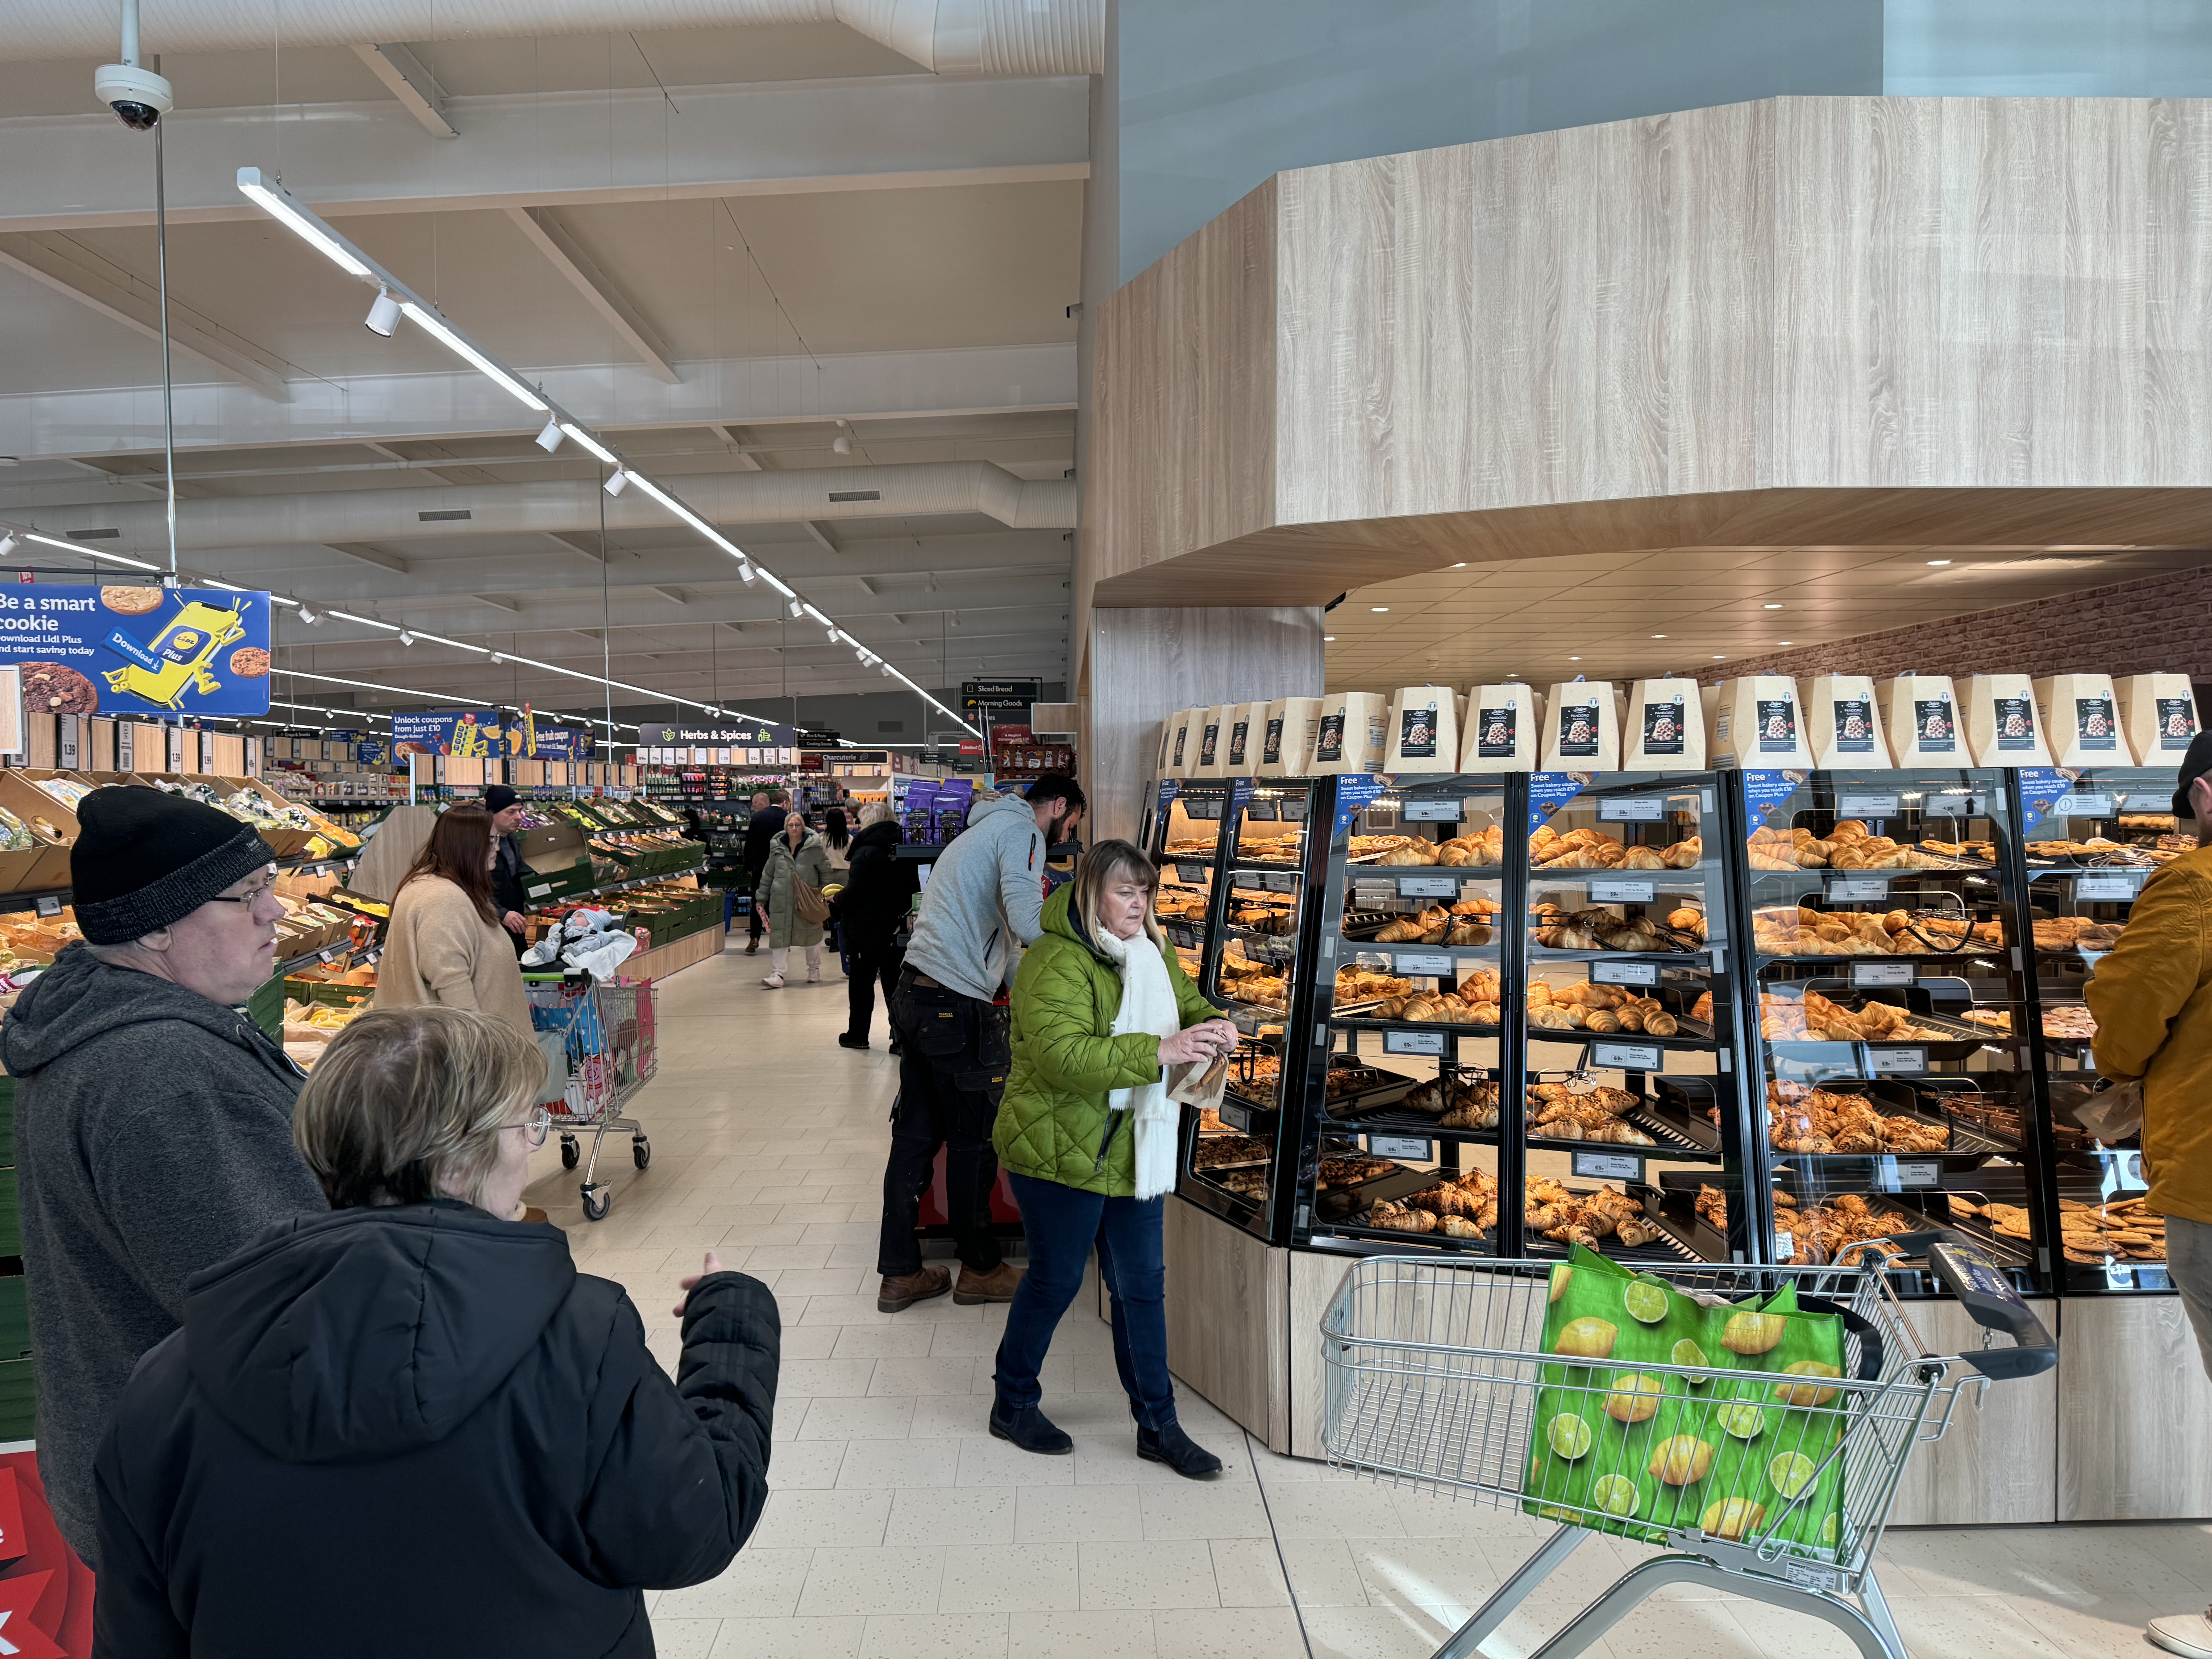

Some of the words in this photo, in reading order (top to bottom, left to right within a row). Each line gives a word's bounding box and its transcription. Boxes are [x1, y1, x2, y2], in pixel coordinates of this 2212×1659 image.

[0, 592, 19, 609] Be
[24, 599, 36, 610] a
[40, 598, 96, 611] smart
[0, 615, 58, 631] cookie
[0, 634, 41, 643] ownload
[43, 635, 60, 643] Lidl
[62, 635, 82, 644] Plus
[0, 645, 11, 653] nd
[36, 646, 67, 656] saving
[69, 647, 94, 656] today
[112, 632, 154, 665] Download
[162, 648, 183, 661] Plus
[413, 725, 427, 733] just
[680, 730, 708, 740] Herbs
[711, 730, 719, 740] &
[721, 730, 752, 742] Spices
[64, 744, 76, 756] 1.39
[1530, 773, 1549, 781] Free
[1747, 773, 1765, 781] Free
[2020, 769, 2039, 778] Free
